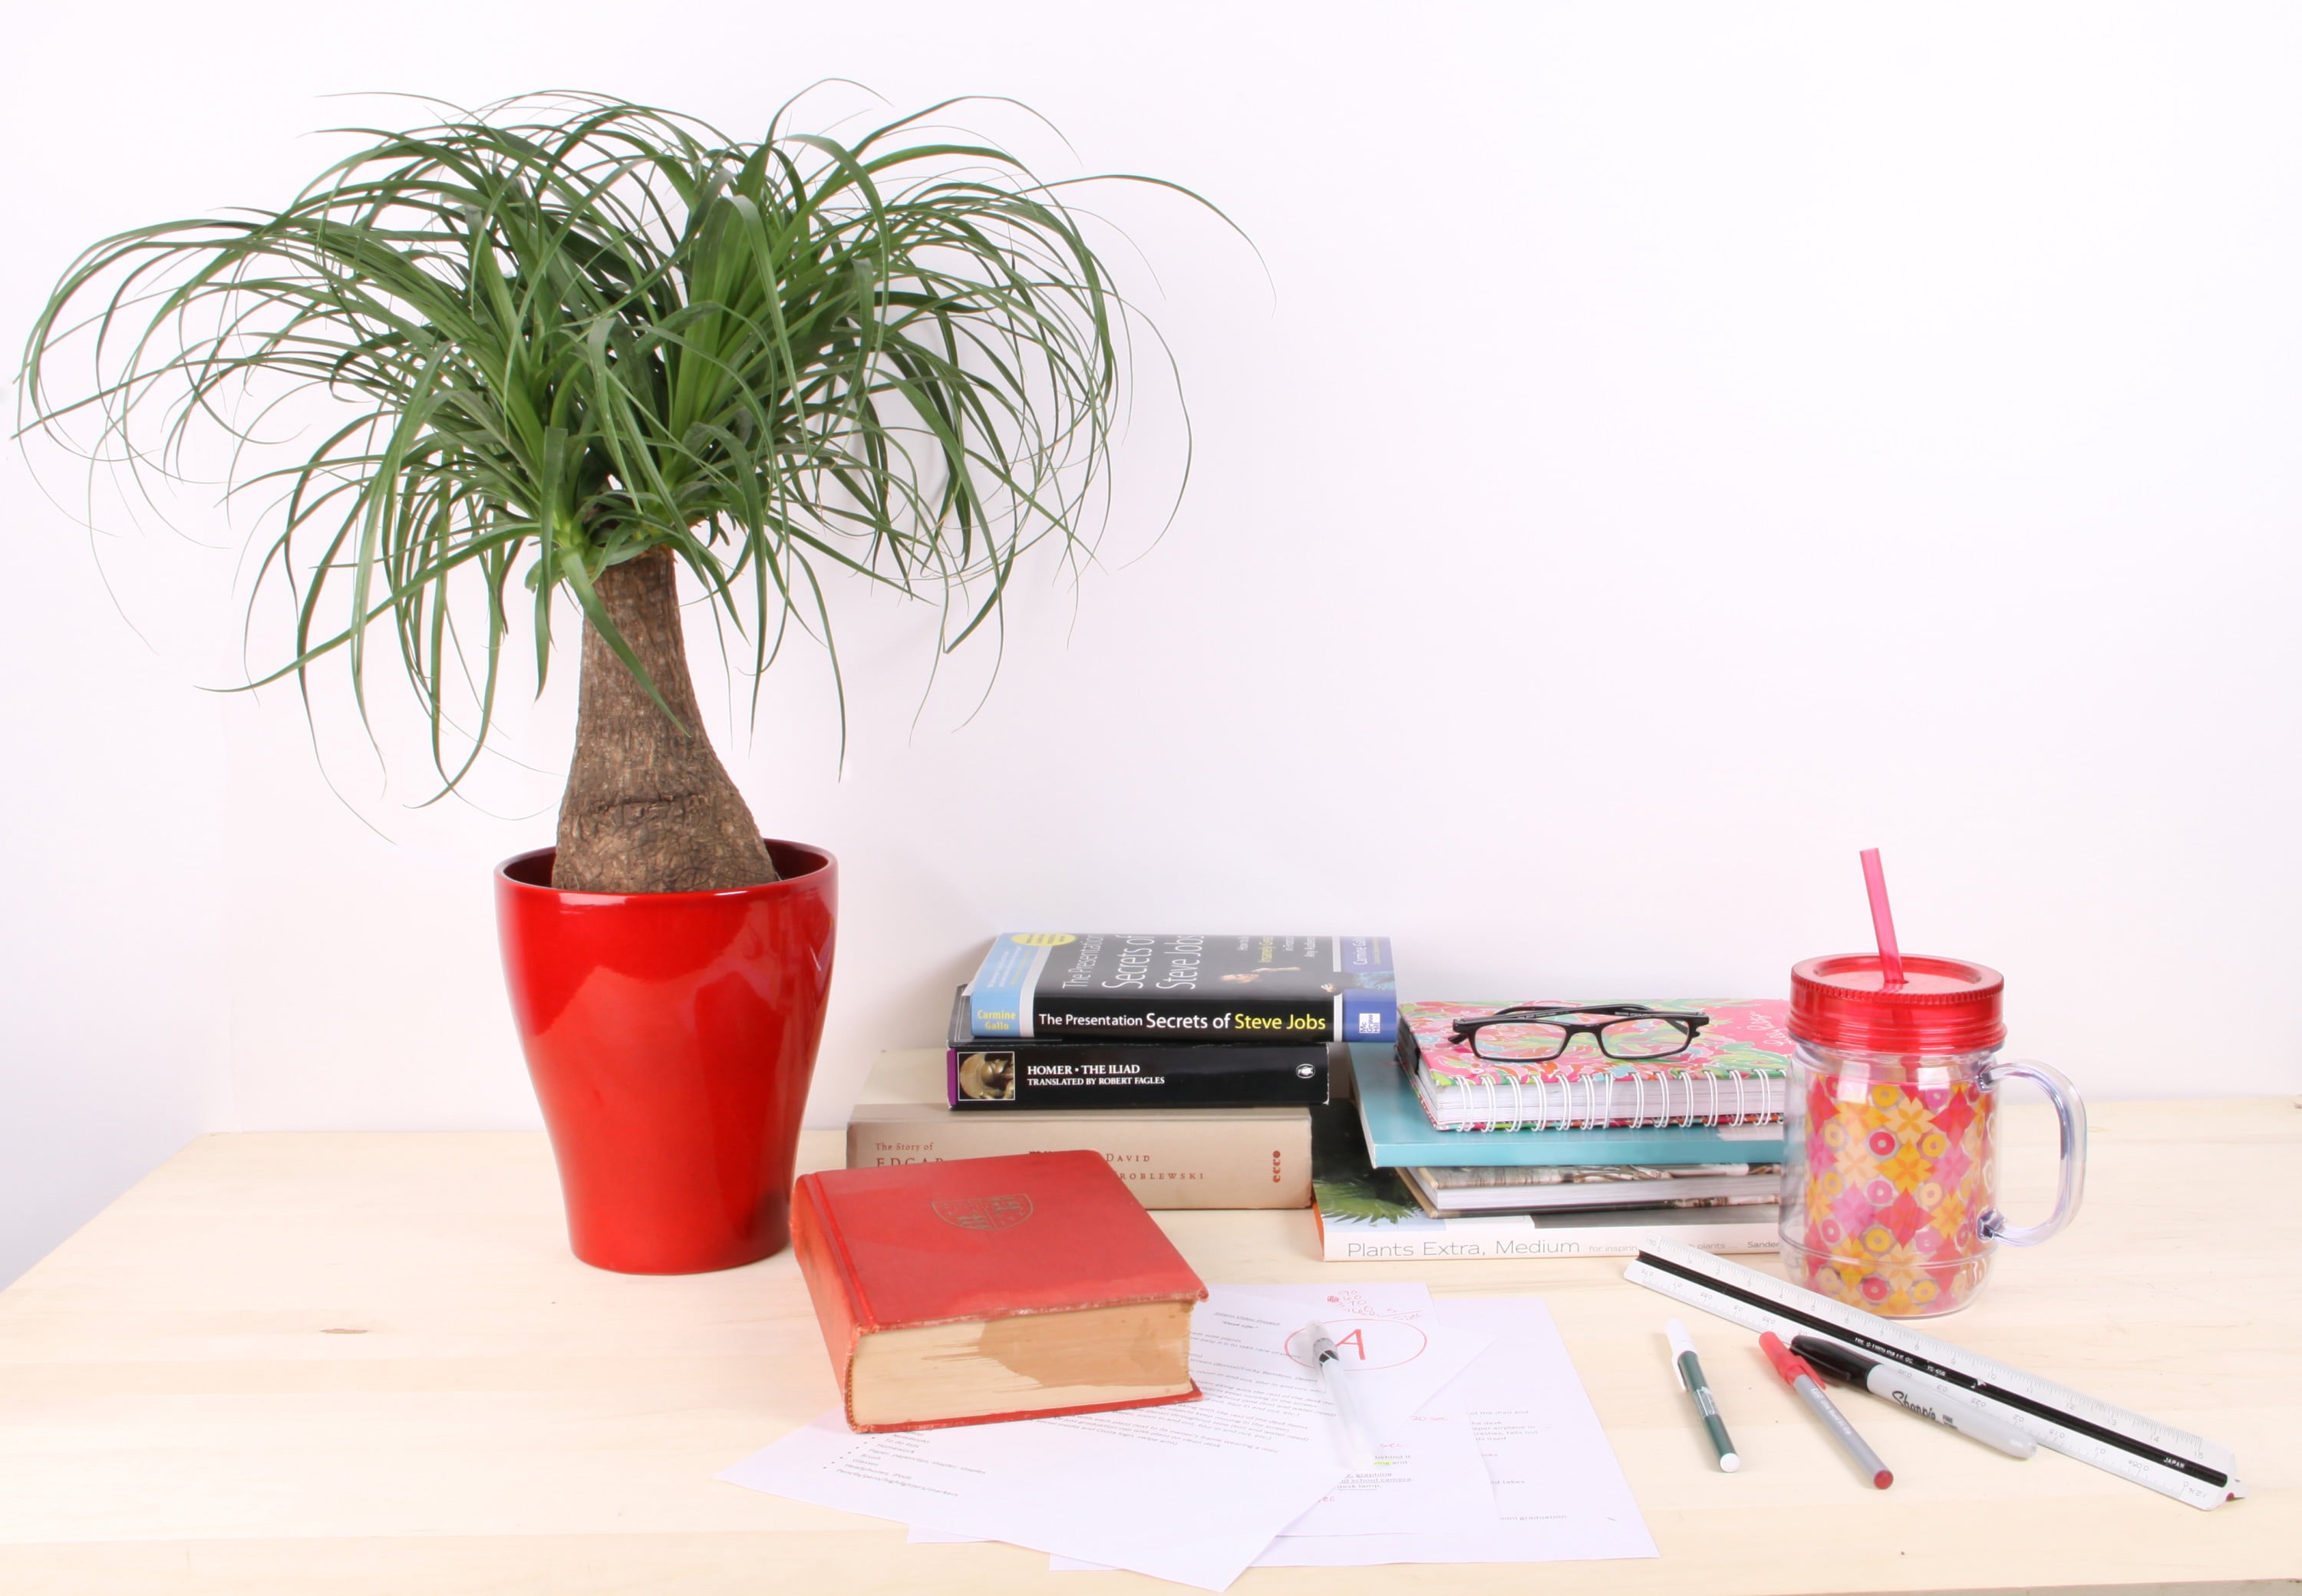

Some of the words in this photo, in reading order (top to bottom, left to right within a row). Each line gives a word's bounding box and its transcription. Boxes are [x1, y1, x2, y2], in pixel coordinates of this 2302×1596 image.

[1164, 935, 1205, 957] Jobs
[1102, 948, 1152, 989] Secrets
[1156, 958, 1200, 990] Steve
[1062, 974, 1091, 988] The
[978, 1010, 1017, 1020] Carmine
[1039, 1014, 1063, 1025] The
[1066, 1014, 1143, 1026] Presentation
[1146, 1012, 1208, 1029] Secrets
[1212, 1012, 1232, 1029] of
[1235, 1013, 1282, 1030] Steve
[1285, 1014, 1326, 1030] Jobs
[985, 1021, 1010, 1030] Gallo
[1027, 1065, 1073, 1074] HOMER
[1080, 1064, 1106, 1074] THE
[1109, 1063, 1140, 1073] ILIAD
[1134, 1076, 1165, 1084] FAGLES
[876, 1143, 892, 1151] The
[896, 1143, 920, 1152] Story
[923, 1142, 934, 1151] of
[1106, 1153, 1151, 1162] DAVID
[1272, 1150, 1281, 1182] ecco
[1347, 1242, 1414, 1257] Plants
[1423, 1241, 1486, 1256] Extra,
[1496, 1239, 1580, 1254] Medium
[1697, 1242, 1726, 1251] plants
[1336, 1329, 1366, 1360] A
[1986, 1371, 1997, 1380] 10
[2025, 1386, 2034, 1394] 11
[2065, 1401, 2076, 1410] 12
[2106, 1417, 2117, 1426] 13
[2149, 1433, 2160, 1443] 14
[2193, 1450, 2204, 1459] 15
[2163, 1456, 2185, 1469] JAPAN
